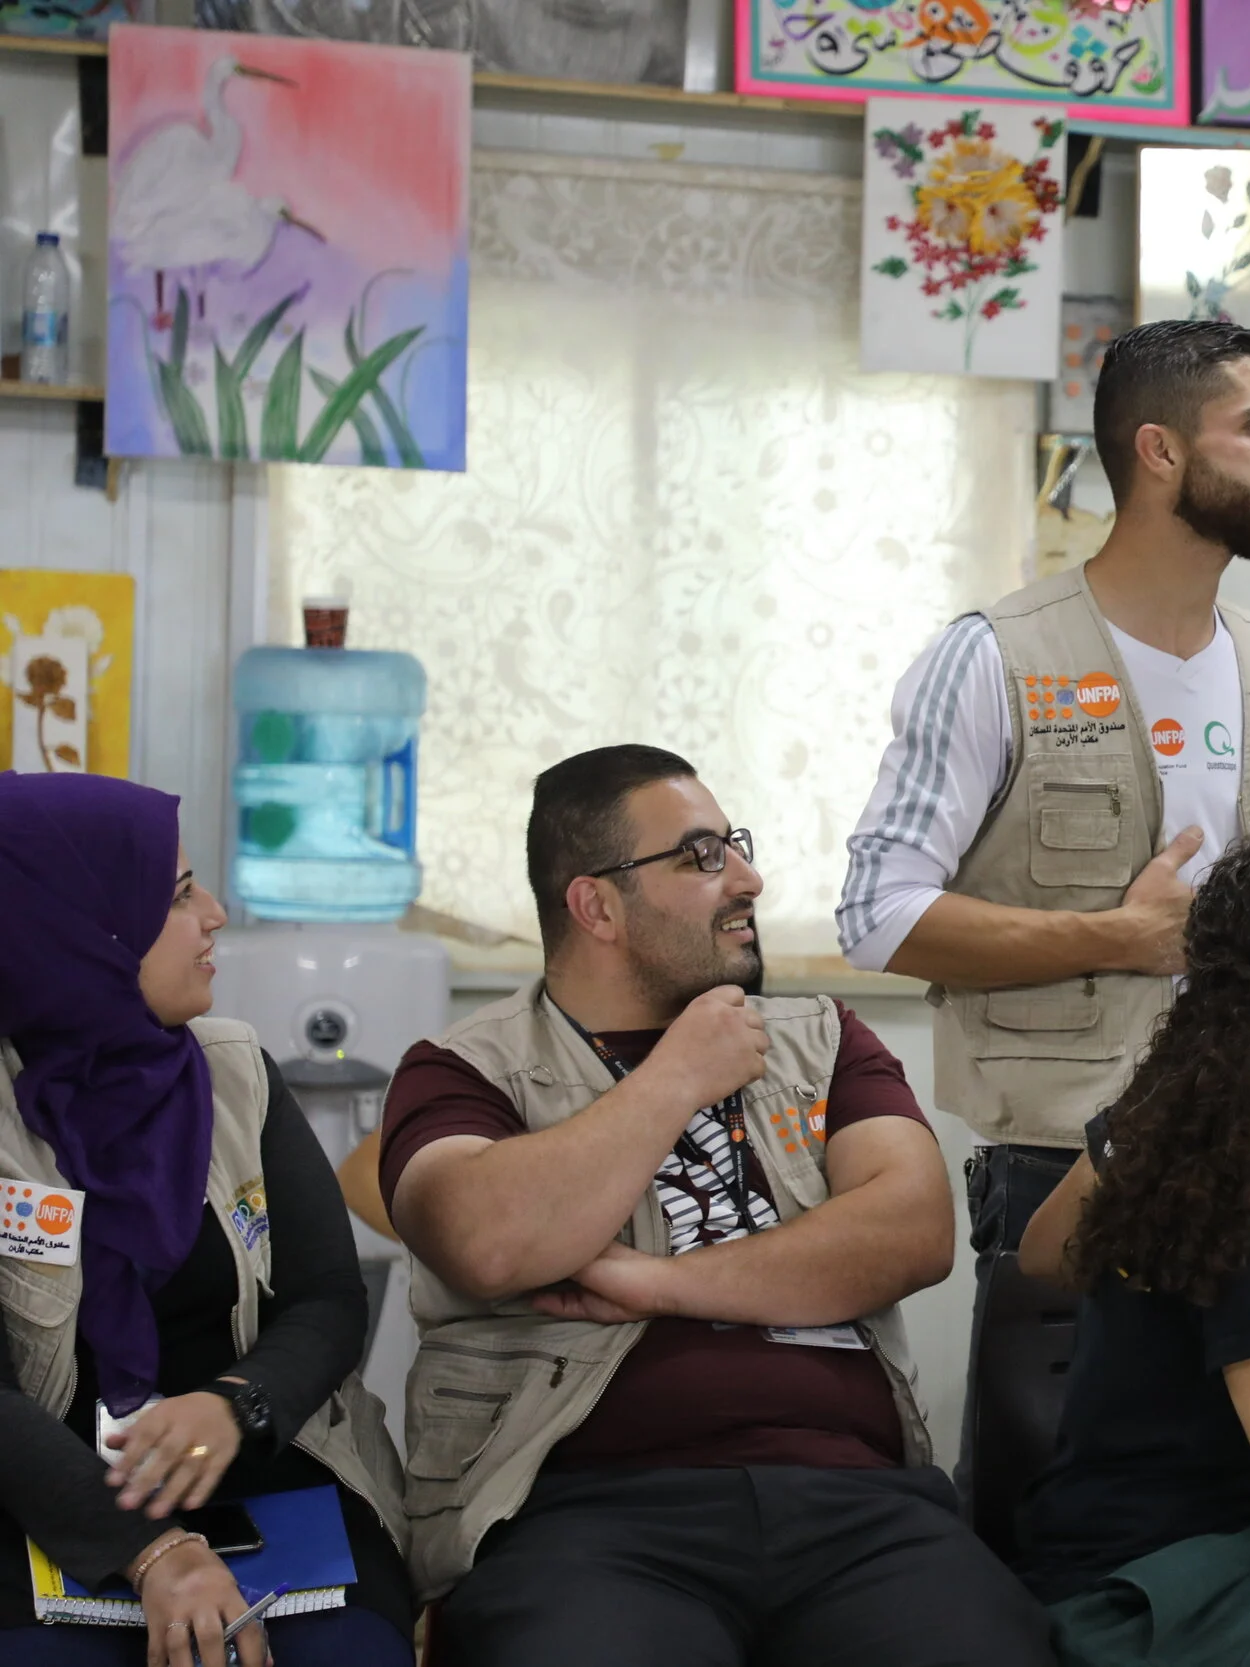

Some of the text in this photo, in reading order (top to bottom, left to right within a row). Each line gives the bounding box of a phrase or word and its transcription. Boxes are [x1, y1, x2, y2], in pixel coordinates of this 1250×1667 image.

[1076, 684, 1121, 704] UNFPA
[1099, 721, 1126, 735] صندوق
[36, 1204, 75, 1224] UNFPA
